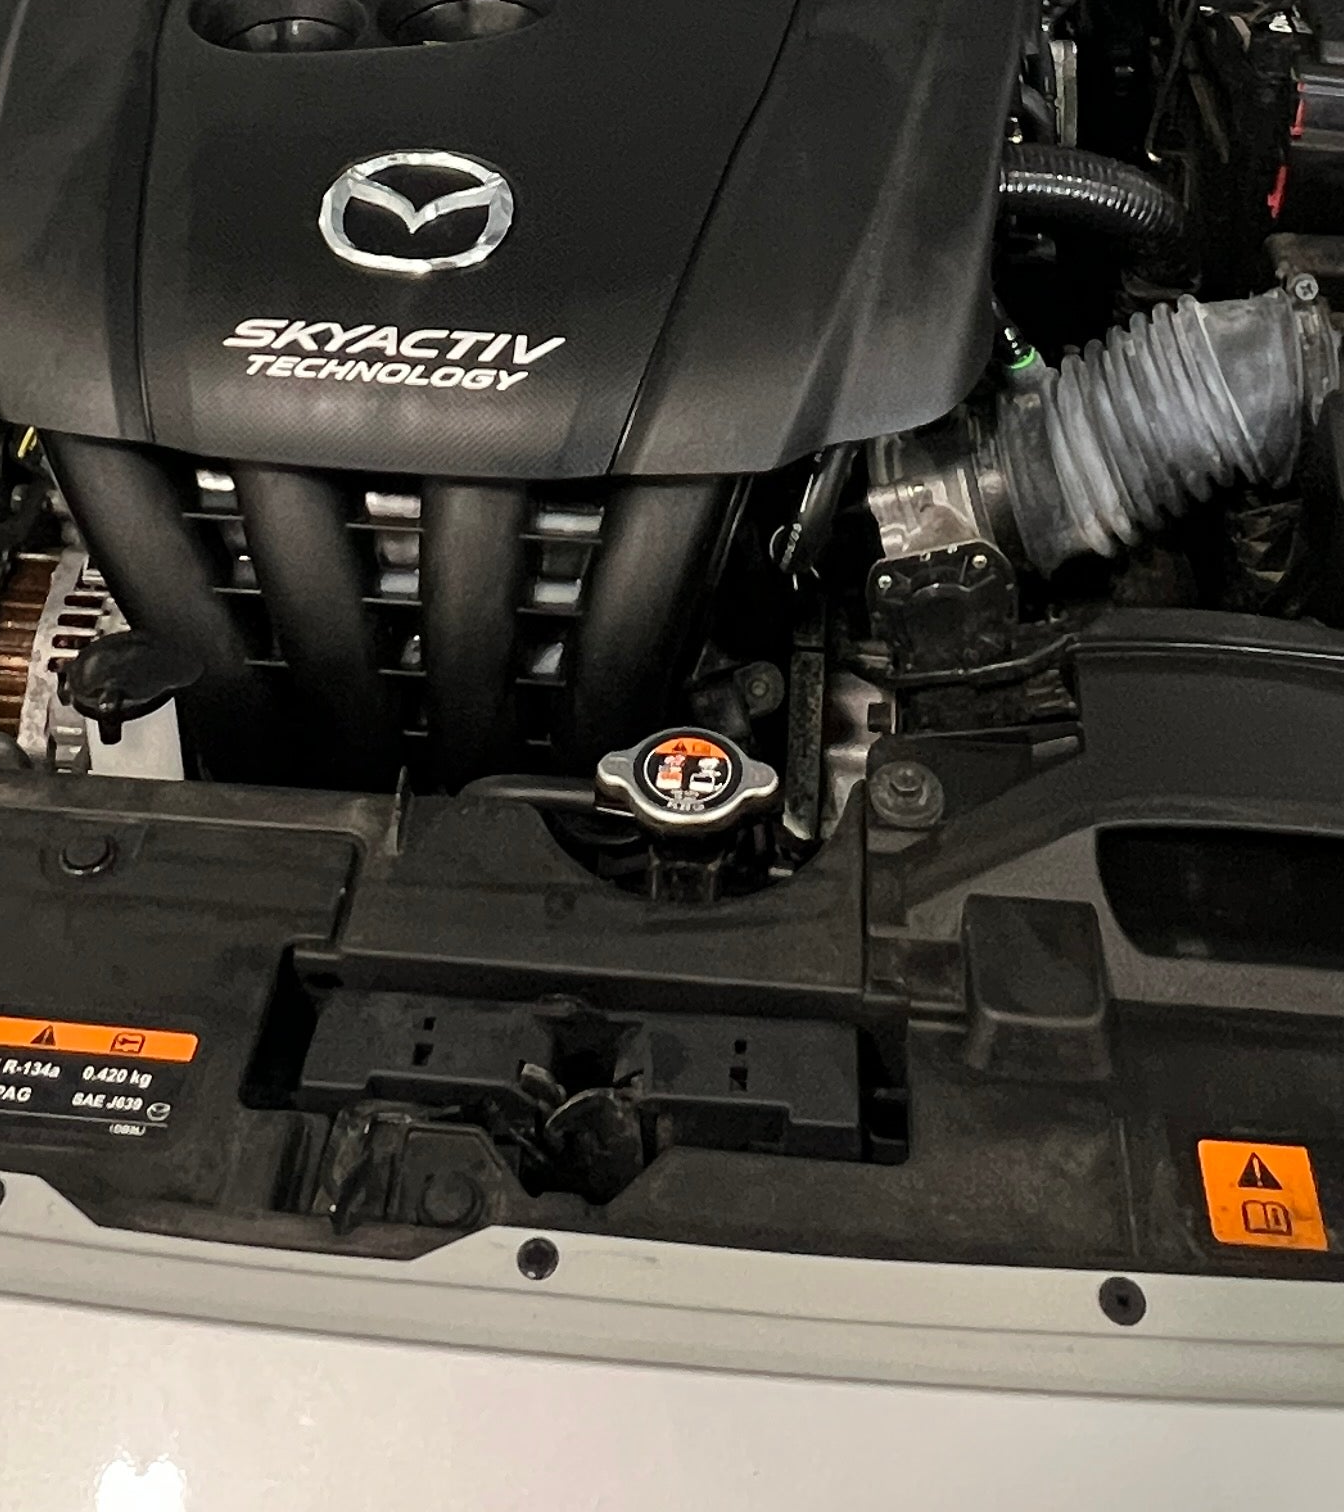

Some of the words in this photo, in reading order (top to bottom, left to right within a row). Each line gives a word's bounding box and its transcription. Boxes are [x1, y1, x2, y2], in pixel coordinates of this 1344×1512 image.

[223, 318, 566, 365] SKYACTIV
[246, 354, 529, 391] TECHNOLOGY
[2, 1059, 61, 1078] R-134a
[129, 1069, 153, 1089] kg
[71, 1092, 106, 1108] SAE
